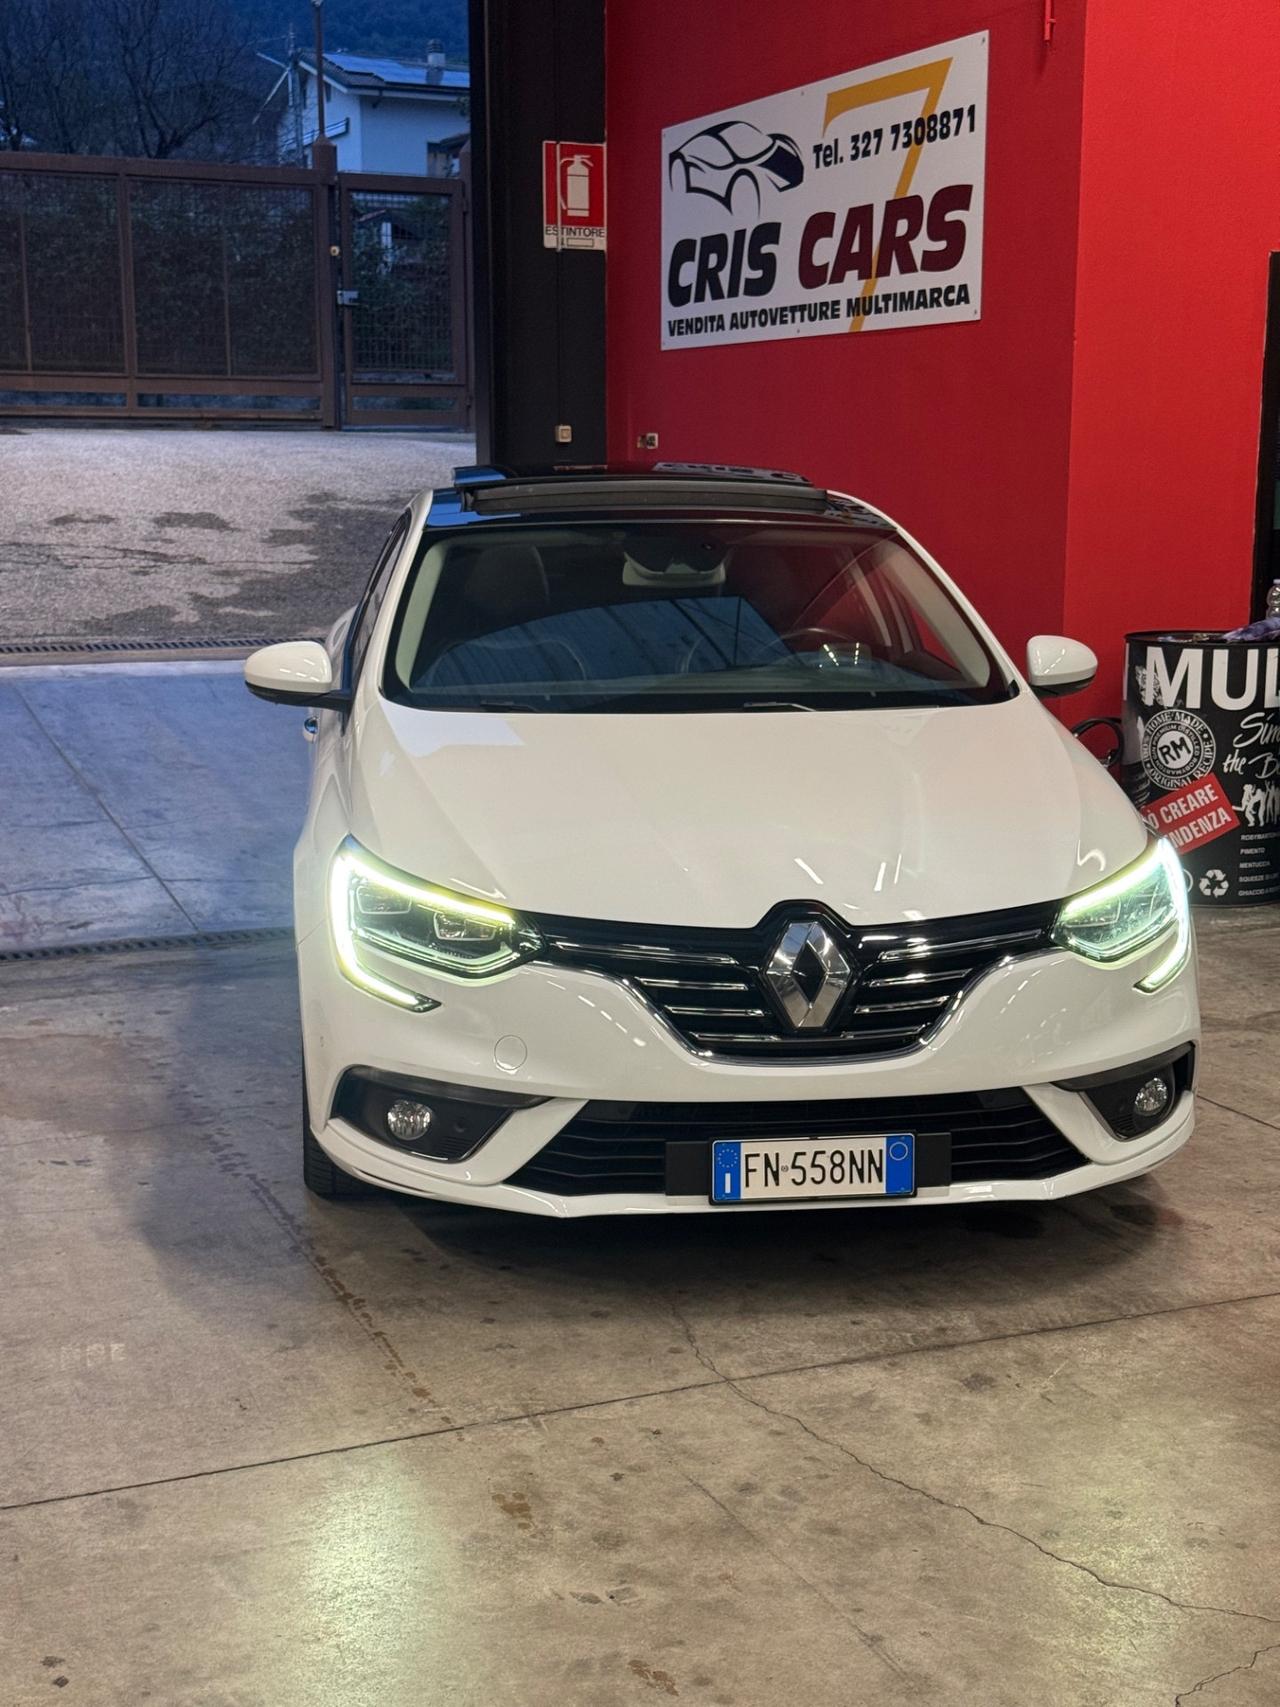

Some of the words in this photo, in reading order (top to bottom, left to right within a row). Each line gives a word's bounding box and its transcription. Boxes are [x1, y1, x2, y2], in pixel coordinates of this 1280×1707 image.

[812, 138, 844, 169] Tel.
[850, 128, 883, 161] 327
[890, 104, 976, 151] 7308871
[546, 225, 605, 238] ESTINTORE
[668, 222, 781, 307] CRIS
[798, 184, 973, 290] CARS
[668, 316, 725, 337] VENDITA
[729, 300, 840, 331] AUTOVETTURE
[846, 283, 970, 318] MULTIMARCA
[1146, 711, 1173, 735] HOME
[1174, 711, 1206, 735] MADE
[1159, 736, 1192, 765] RM
[1222, 749, 1248, 775] the
[1160, 784, 1219, 824] CREARE
